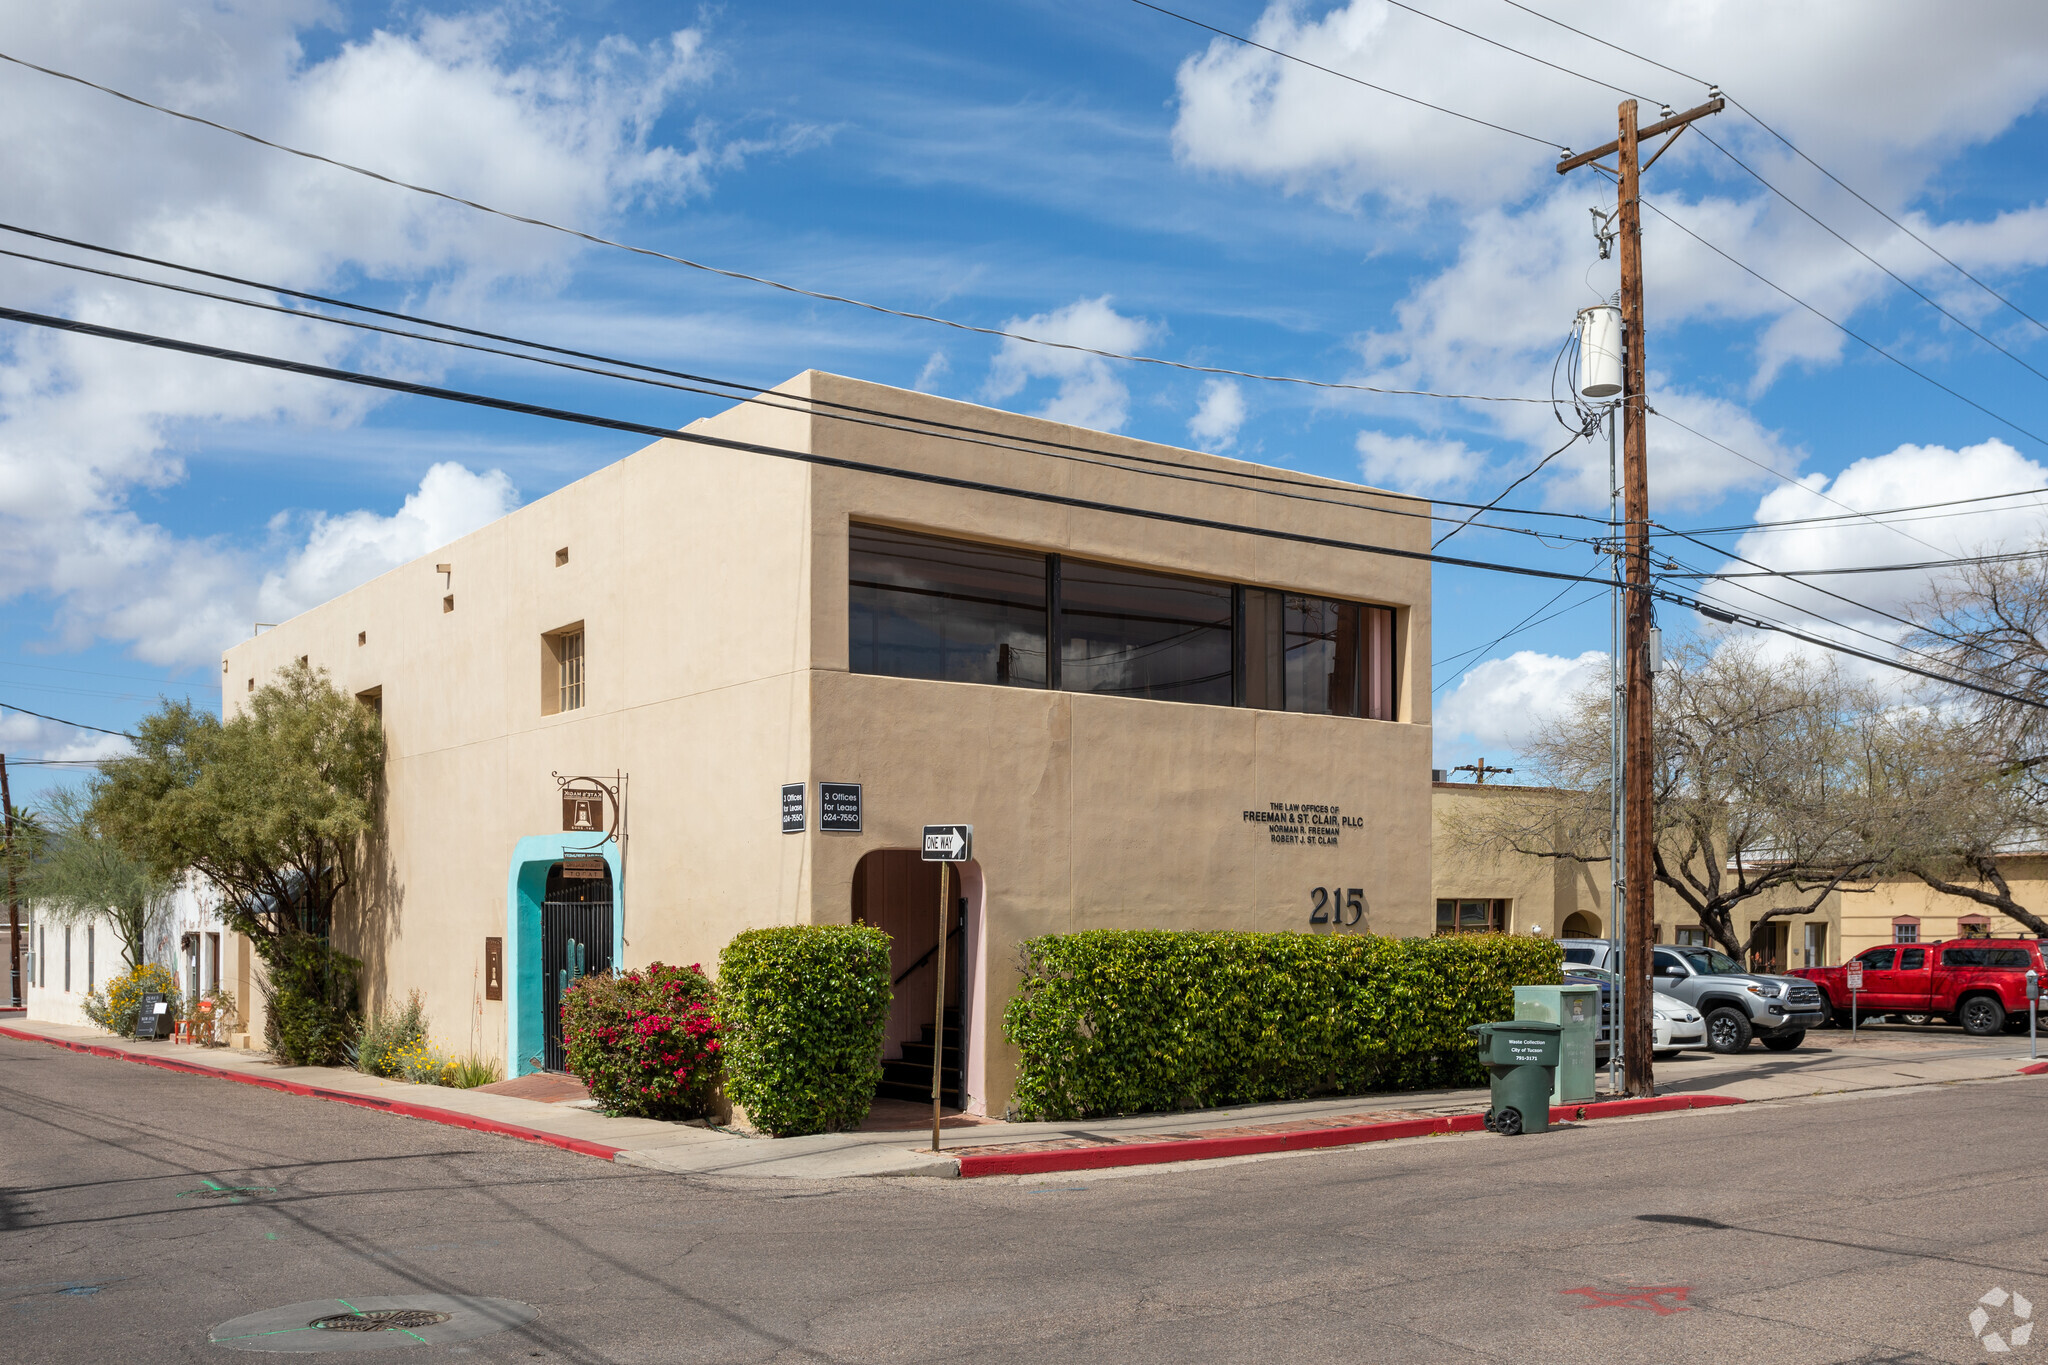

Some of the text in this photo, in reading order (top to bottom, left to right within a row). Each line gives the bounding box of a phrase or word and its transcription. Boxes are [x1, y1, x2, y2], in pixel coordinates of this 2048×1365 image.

[832, 793, 857, 801] Offices
[824, 803, 857, 811] for Lease
[1270, 802, 1283, 811] THE
[1285, 803, 1299, 811] LAW
[1301, 804, 1328, 813] OFFICES
[823, 813, 858, 822] 624-7550
[1243, 811, 1363, 827] FREEMAN & ST. CLAIR, PLLC
[1269, 825, 1339, 835] NORMAN R. FREEMAN
[927, 836, 953, 849] ONE WAY
[1271, 835, 1337, 844] ROBERT J. ST. CLAIR
[1309, 887, 1363, 926] 215
